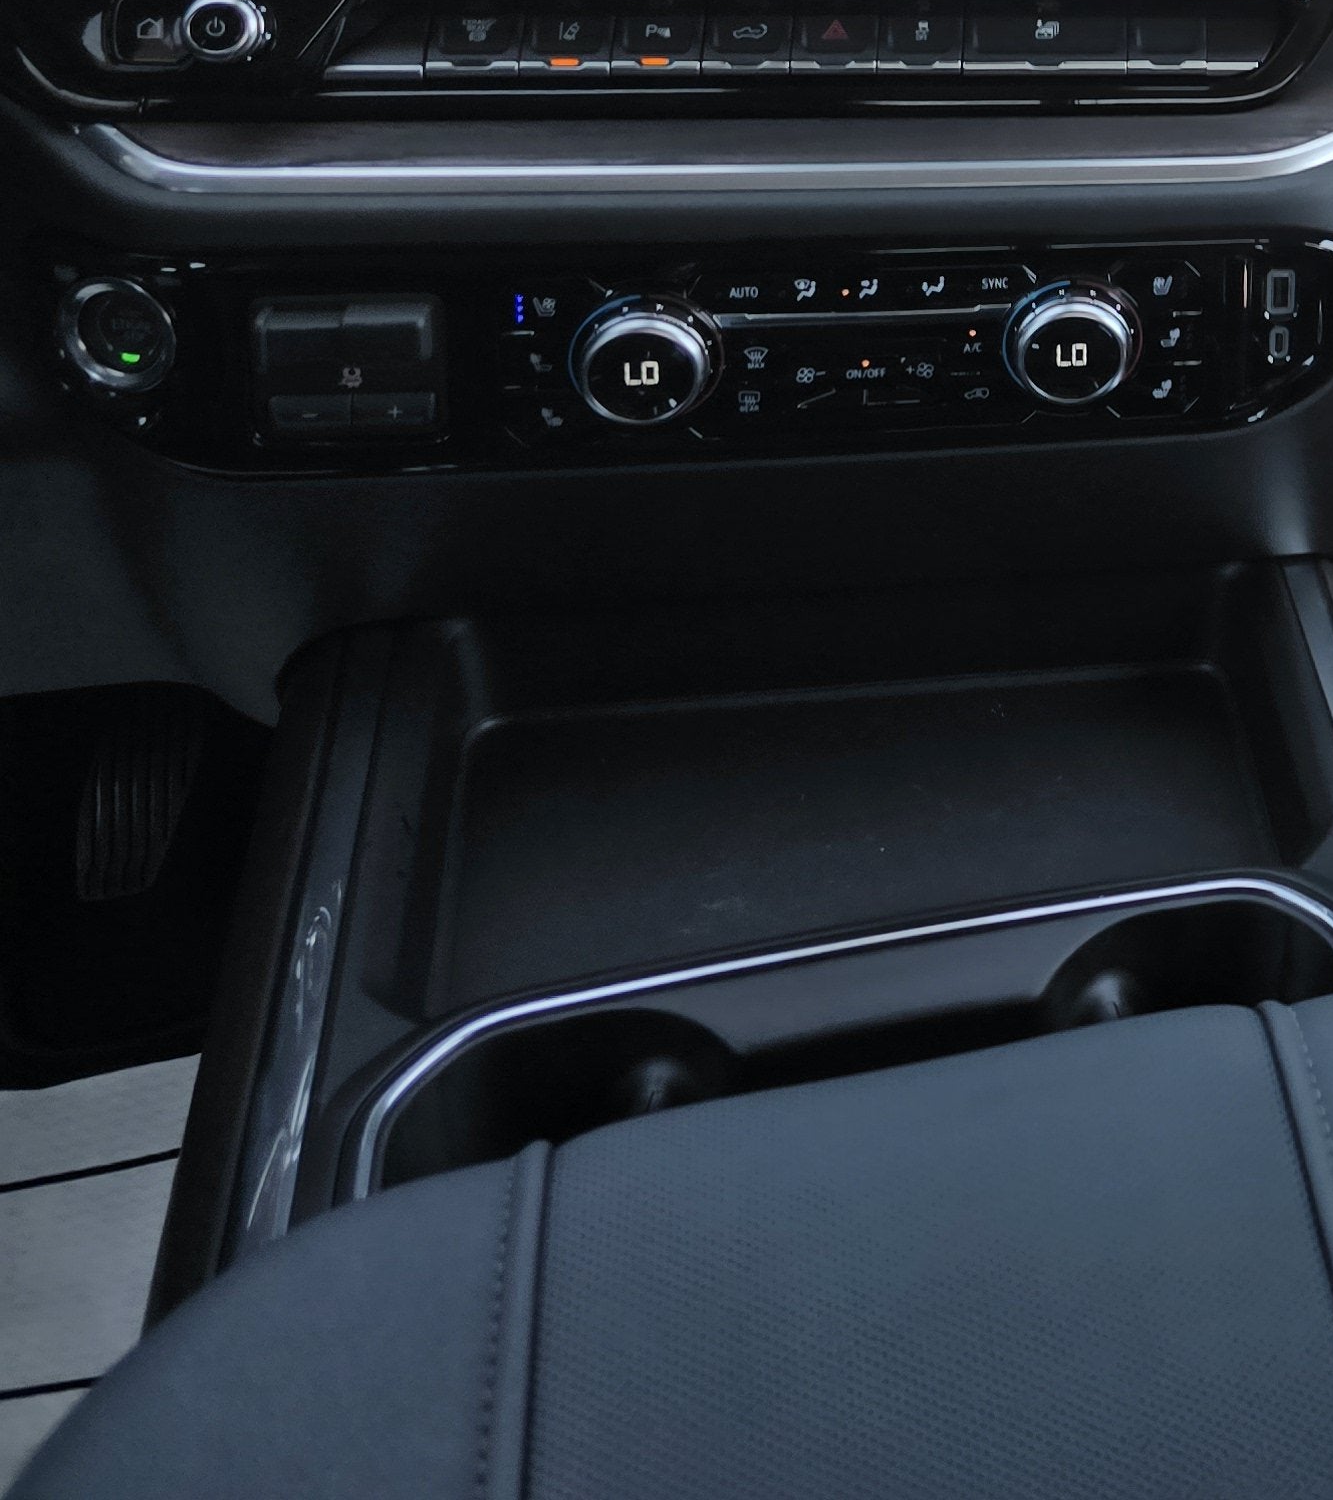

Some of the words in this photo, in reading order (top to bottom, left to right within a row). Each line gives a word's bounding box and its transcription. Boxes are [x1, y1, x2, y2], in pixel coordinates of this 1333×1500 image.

[981, 276, 1009, 290] SYNC
[729, 286, 759, 299] AUTO
[963, 342, 983, 354] A/C
[846, 367, 887, 380] ON/OFF
